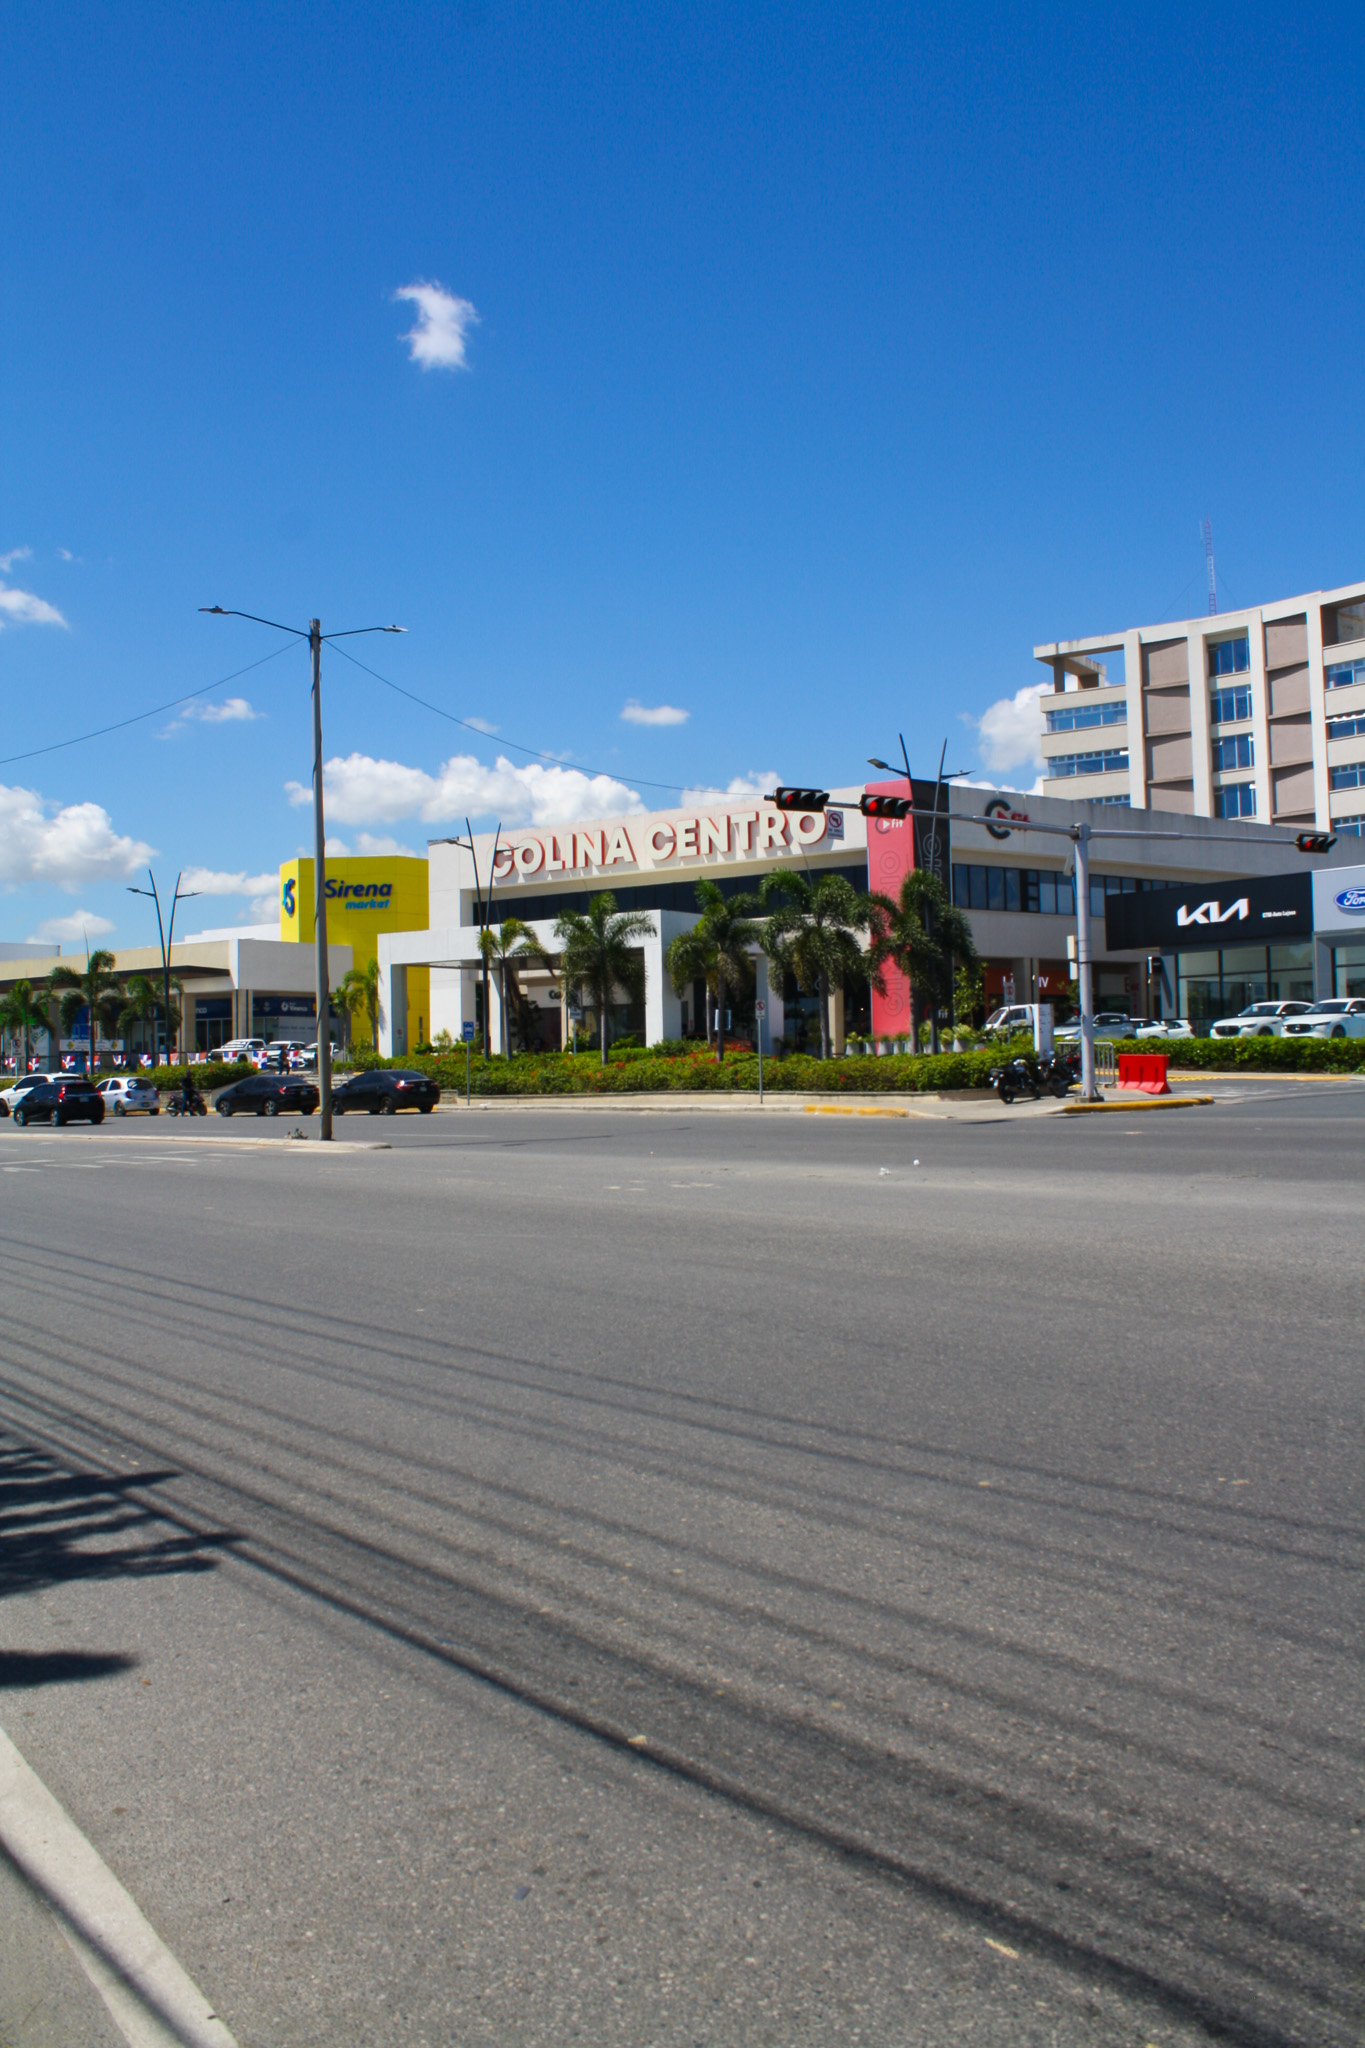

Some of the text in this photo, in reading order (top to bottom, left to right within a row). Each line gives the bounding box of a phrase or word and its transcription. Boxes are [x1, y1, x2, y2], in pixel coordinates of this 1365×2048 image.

[487, 808, 827, 878] COLINA CENTRO
[325, 879, 392, 898] Sirena
[345, 898, 390, 910] market
[1176, 897, 1250, 927] KIA
